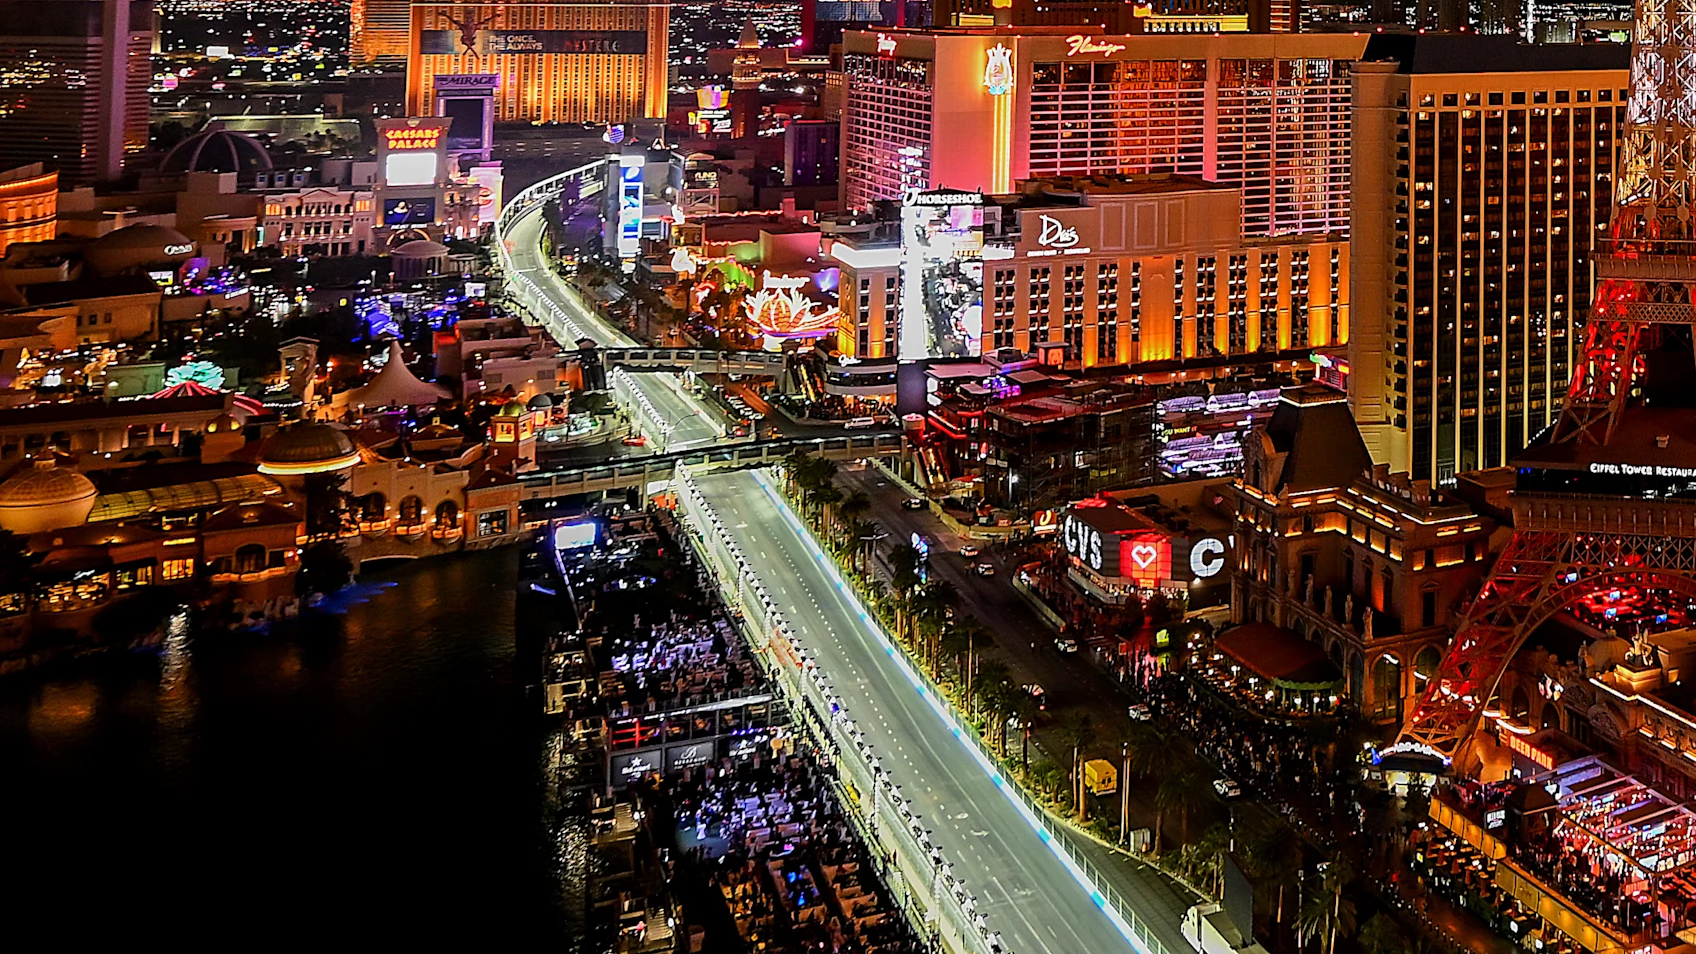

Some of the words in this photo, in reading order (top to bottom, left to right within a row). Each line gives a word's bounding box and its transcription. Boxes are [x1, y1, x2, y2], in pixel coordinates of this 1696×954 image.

[506, 42, 543, 51] ALWAYS
[1066, 34, 1126, 58] Flamingo
[441, 75, 496, 86] MIRAGE
[386, 129, 441, 139] CAESARS
[388, 139, 437, 150] PALACE
[917, 193, 984, 205] HORSESHOE
[1063, 514, 1103, 570] CVS
[1531, 747, 1553, 771] PARK
